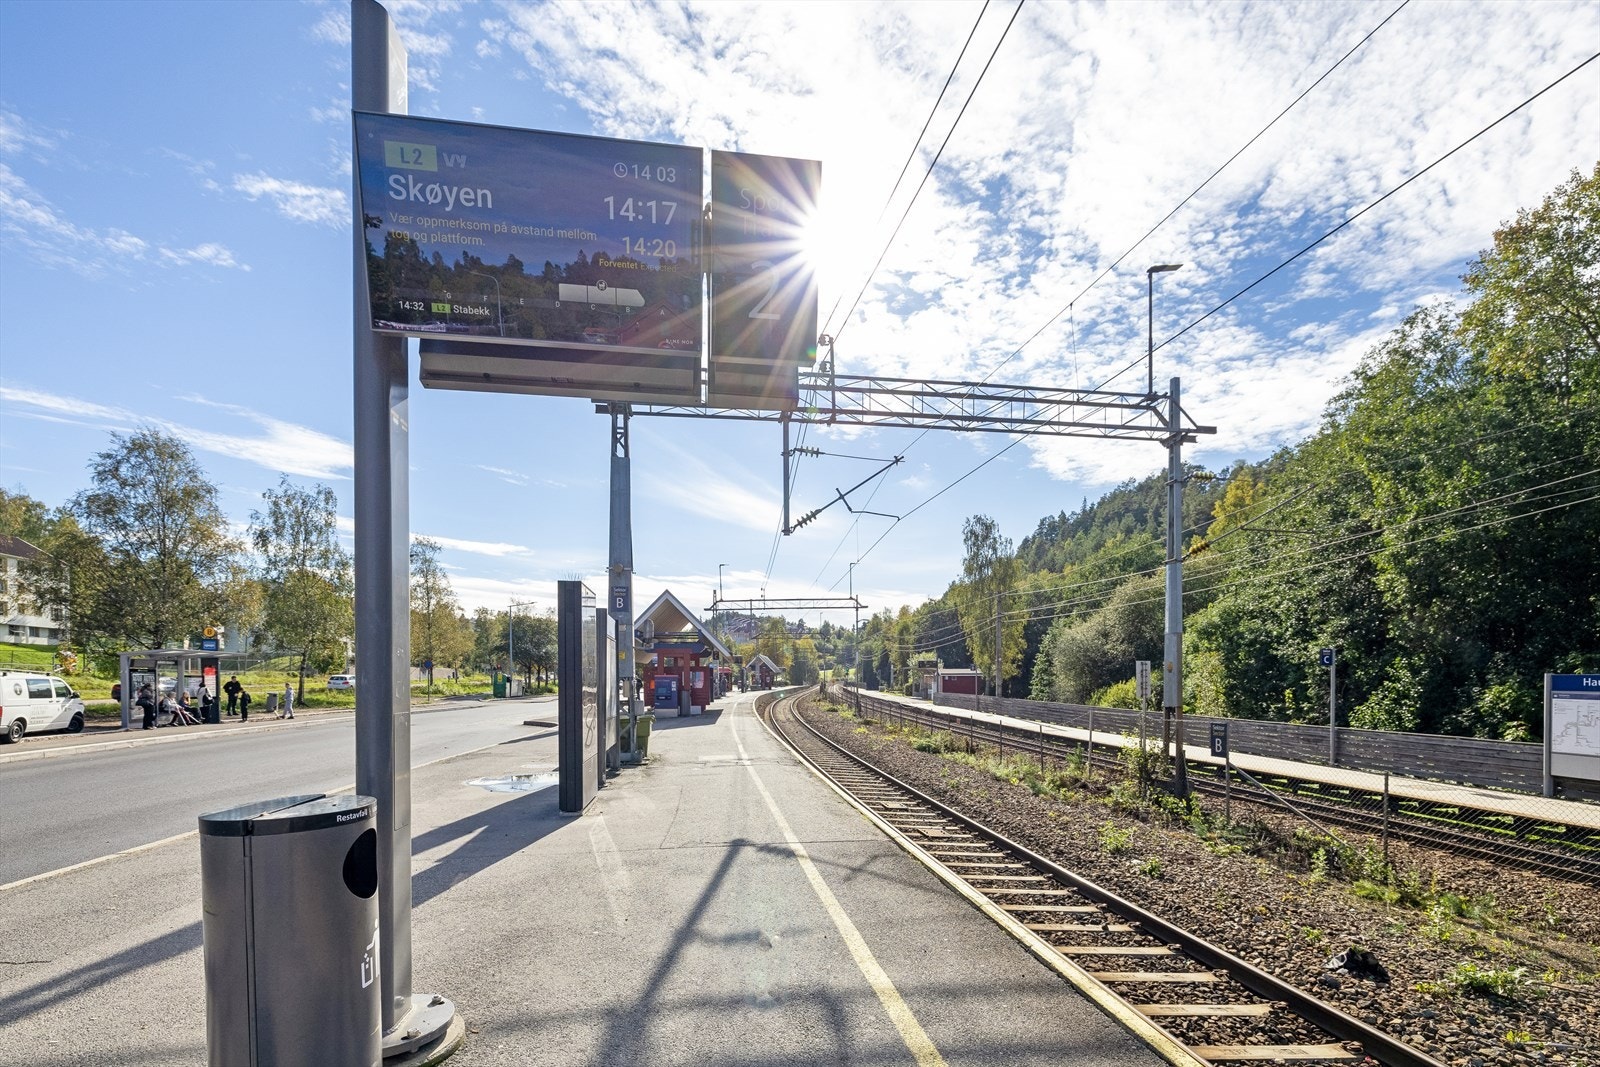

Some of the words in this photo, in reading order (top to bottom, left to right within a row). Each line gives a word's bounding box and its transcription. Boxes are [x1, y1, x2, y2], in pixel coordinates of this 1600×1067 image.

[400, 147, 424, 166] L2
[631, 164, 651, 181] 14
[656, 166, 676, 183] 03
[388, 174, 493, 212] Skøyen
[603, 196, 678, 225] 14:17
[389, 212, 414, 223] Vær
[416, 217, 491, 231] oppmerksom
[494, 222, 508, 234] på
[511, 225, 554, 237] avstand
[557, 228, 597, 241] mellom
[391, 228, 410, 242] tog
[413, 231, 428, 243] og
[431, 232, 486, 246] plattform.
[622, 236, 676, 258] 14:20
[599, 258, 638, 270] Forventet
[748, 261, 781, 320] 2
[398, 300, 424, 311] 14:32
[453, 304, 490, 316] Stabekk
[616, 597, 624, 608] B
[1323, 655, 1330, 664] C
[1215, 738, 1223, 753] B
